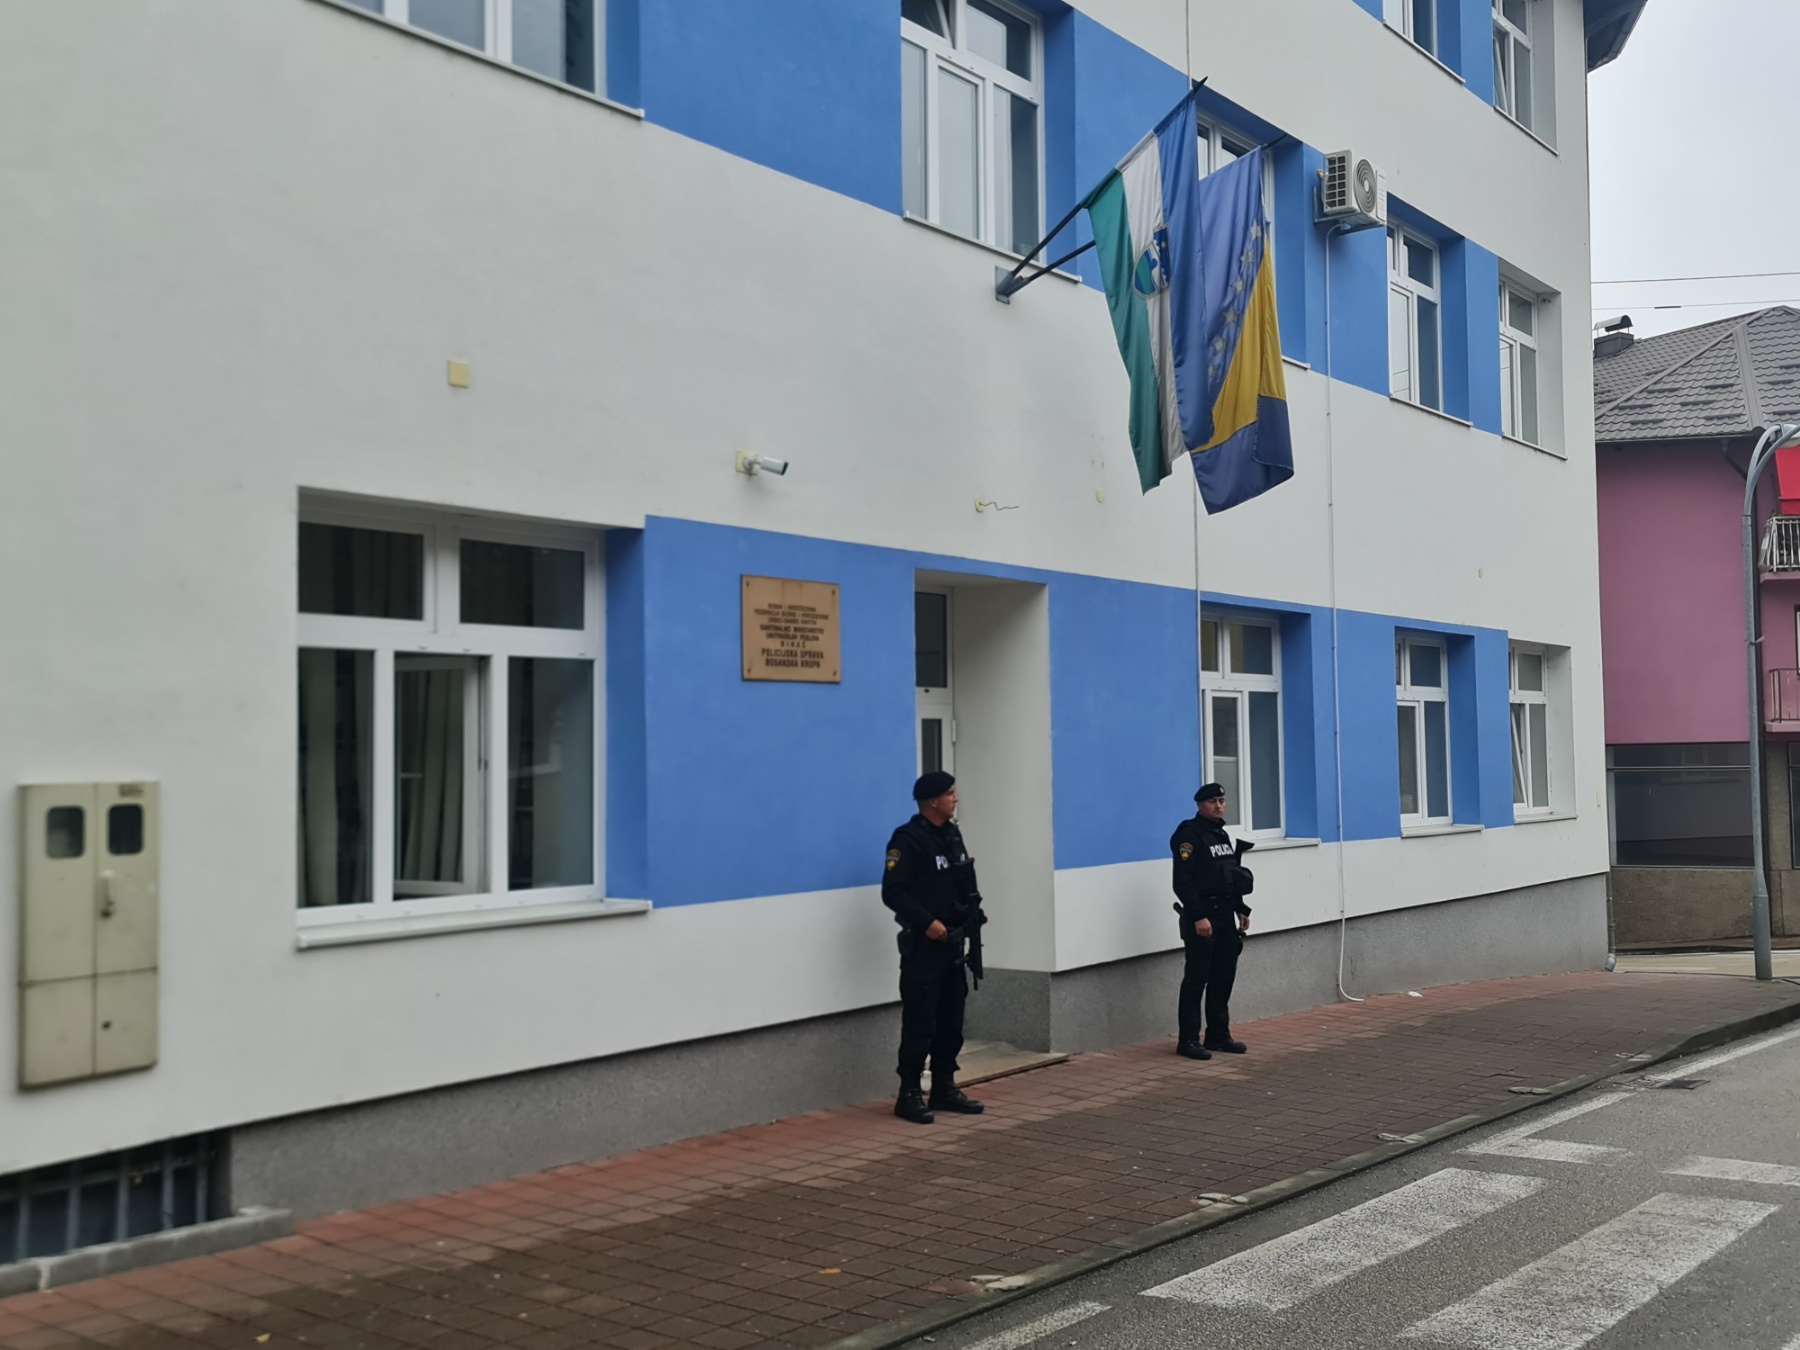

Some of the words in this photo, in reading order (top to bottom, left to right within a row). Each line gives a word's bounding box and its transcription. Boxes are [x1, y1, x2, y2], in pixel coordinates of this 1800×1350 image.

[761, 648, 798, 658] POLICIJSKA
[800, 650, 824, 659] UPRAVA
[765, 658, 798, 667] BOSANSKA
[800, 660, 821, 668] KRUPA
